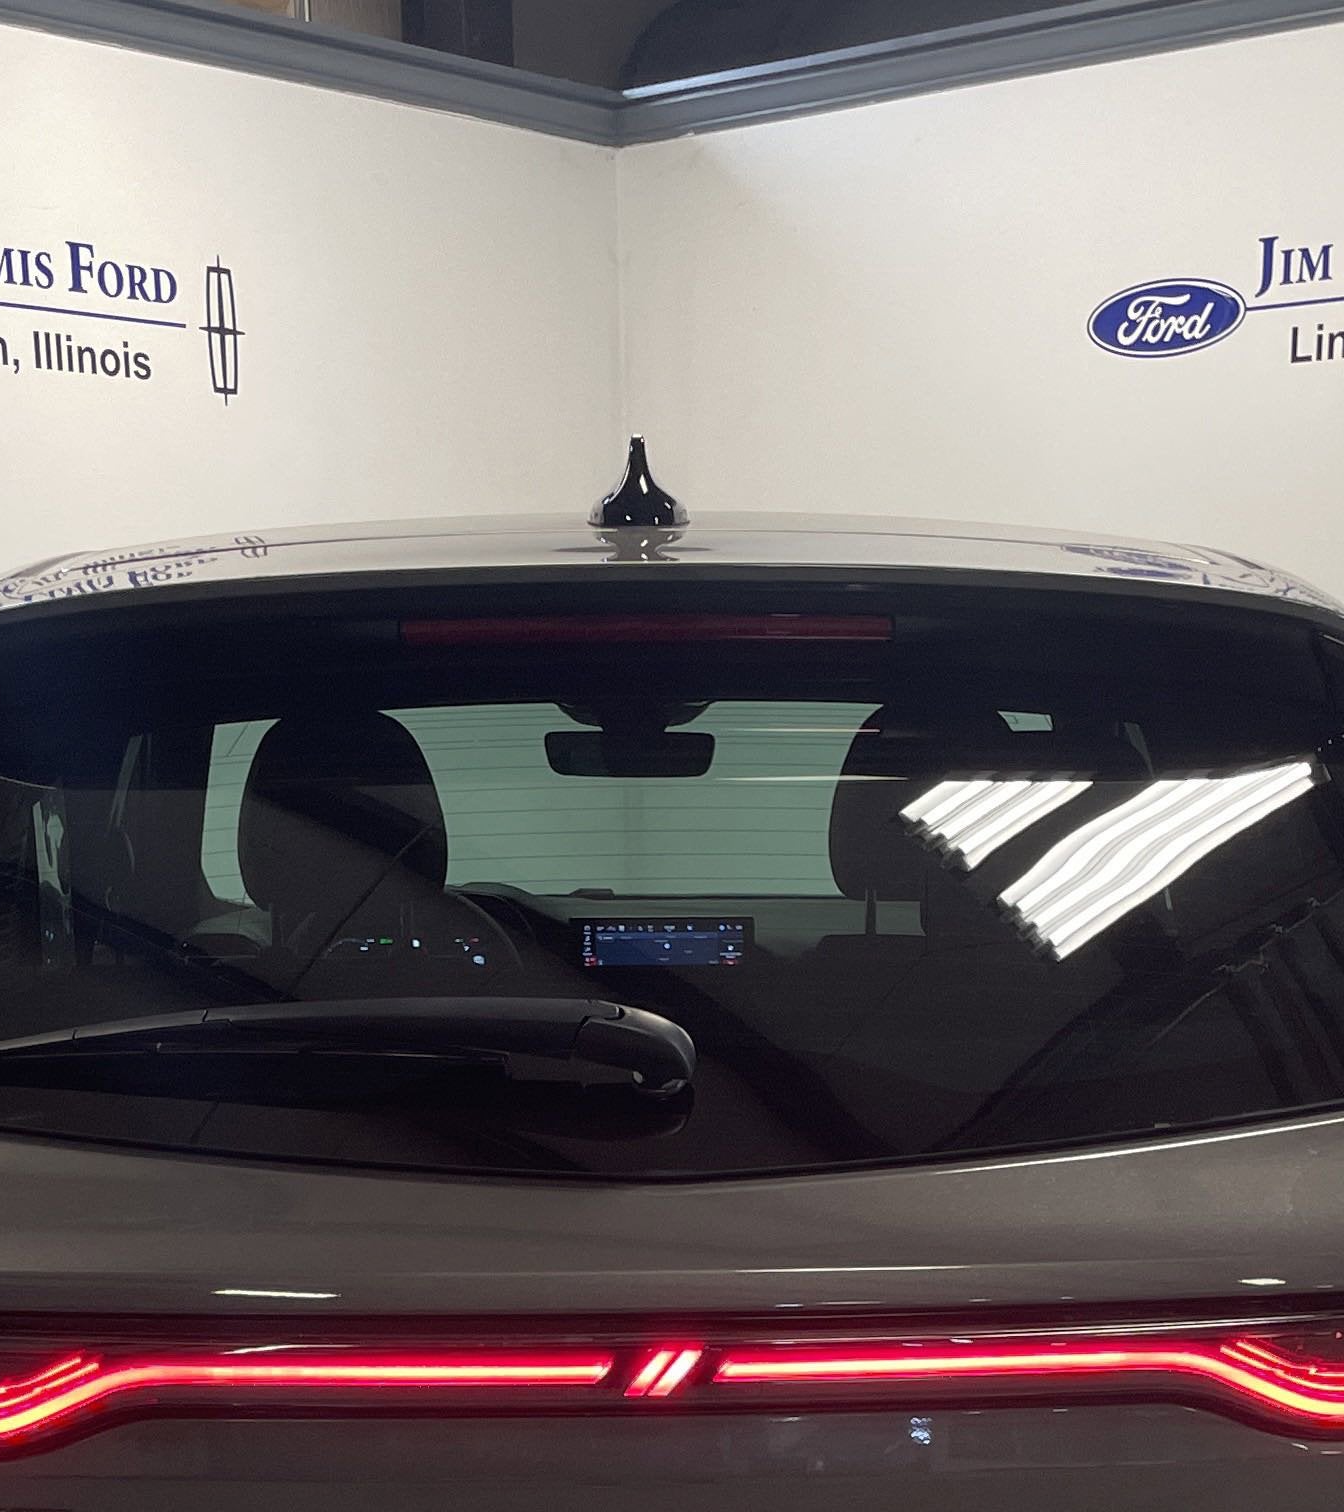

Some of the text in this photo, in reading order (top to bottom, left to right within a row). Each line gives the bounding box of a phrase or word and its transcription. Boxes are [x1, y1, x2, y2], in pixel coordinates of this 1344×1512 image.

[65, 241, 177, 304] FORD
[1255, 235, 1333, 298] JIM
[1117, 293, 1210, 344] Ford
[33, 330, 152, 381] Illinois
